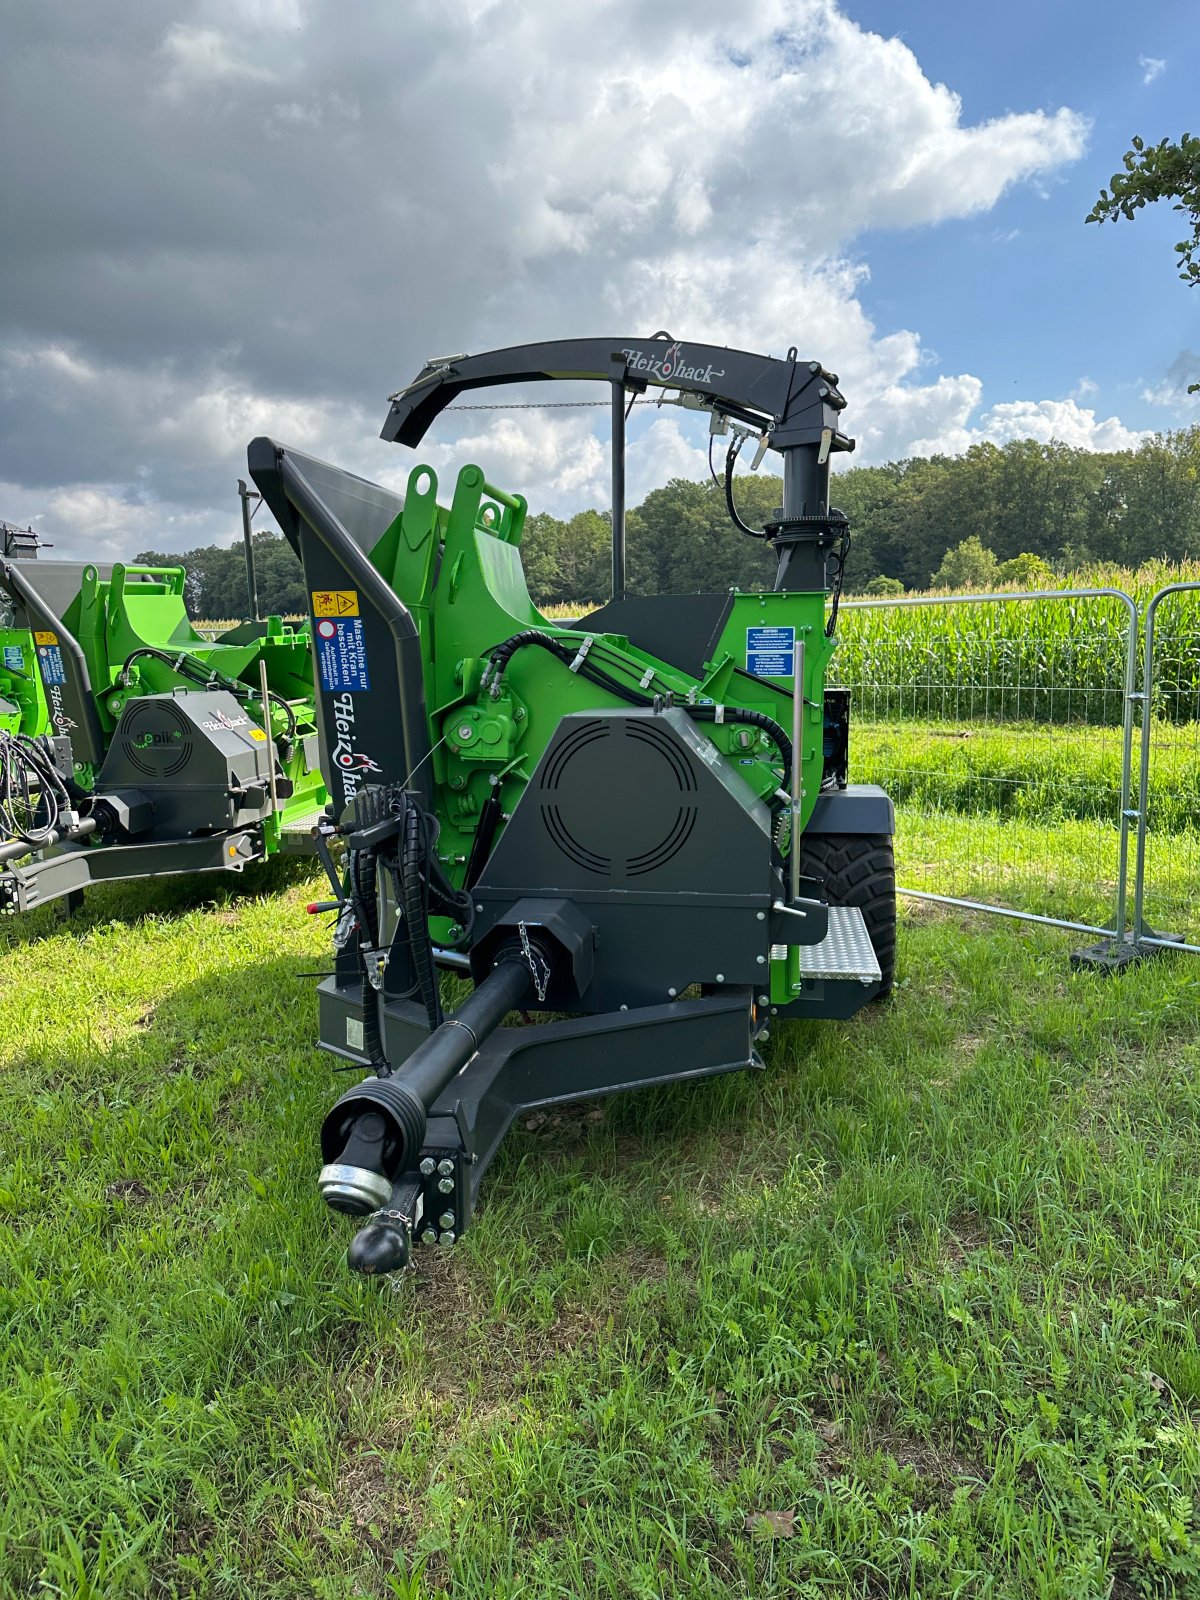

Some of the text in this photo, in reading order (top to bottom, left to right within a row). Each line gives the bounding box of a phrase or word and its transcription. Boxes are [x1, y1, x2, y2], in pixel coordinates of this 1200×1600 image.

[320, 651, 329, 680] verboten!
[324, 641, 335, 690] Gefahrenbereich
[330, 646, 339, 685] Aufenthalt im
[337, 623, 352, 685] beschicken!
[346, 632, 358, 677] mit Kran
[353, 619, 368, 689] Maschine nur
